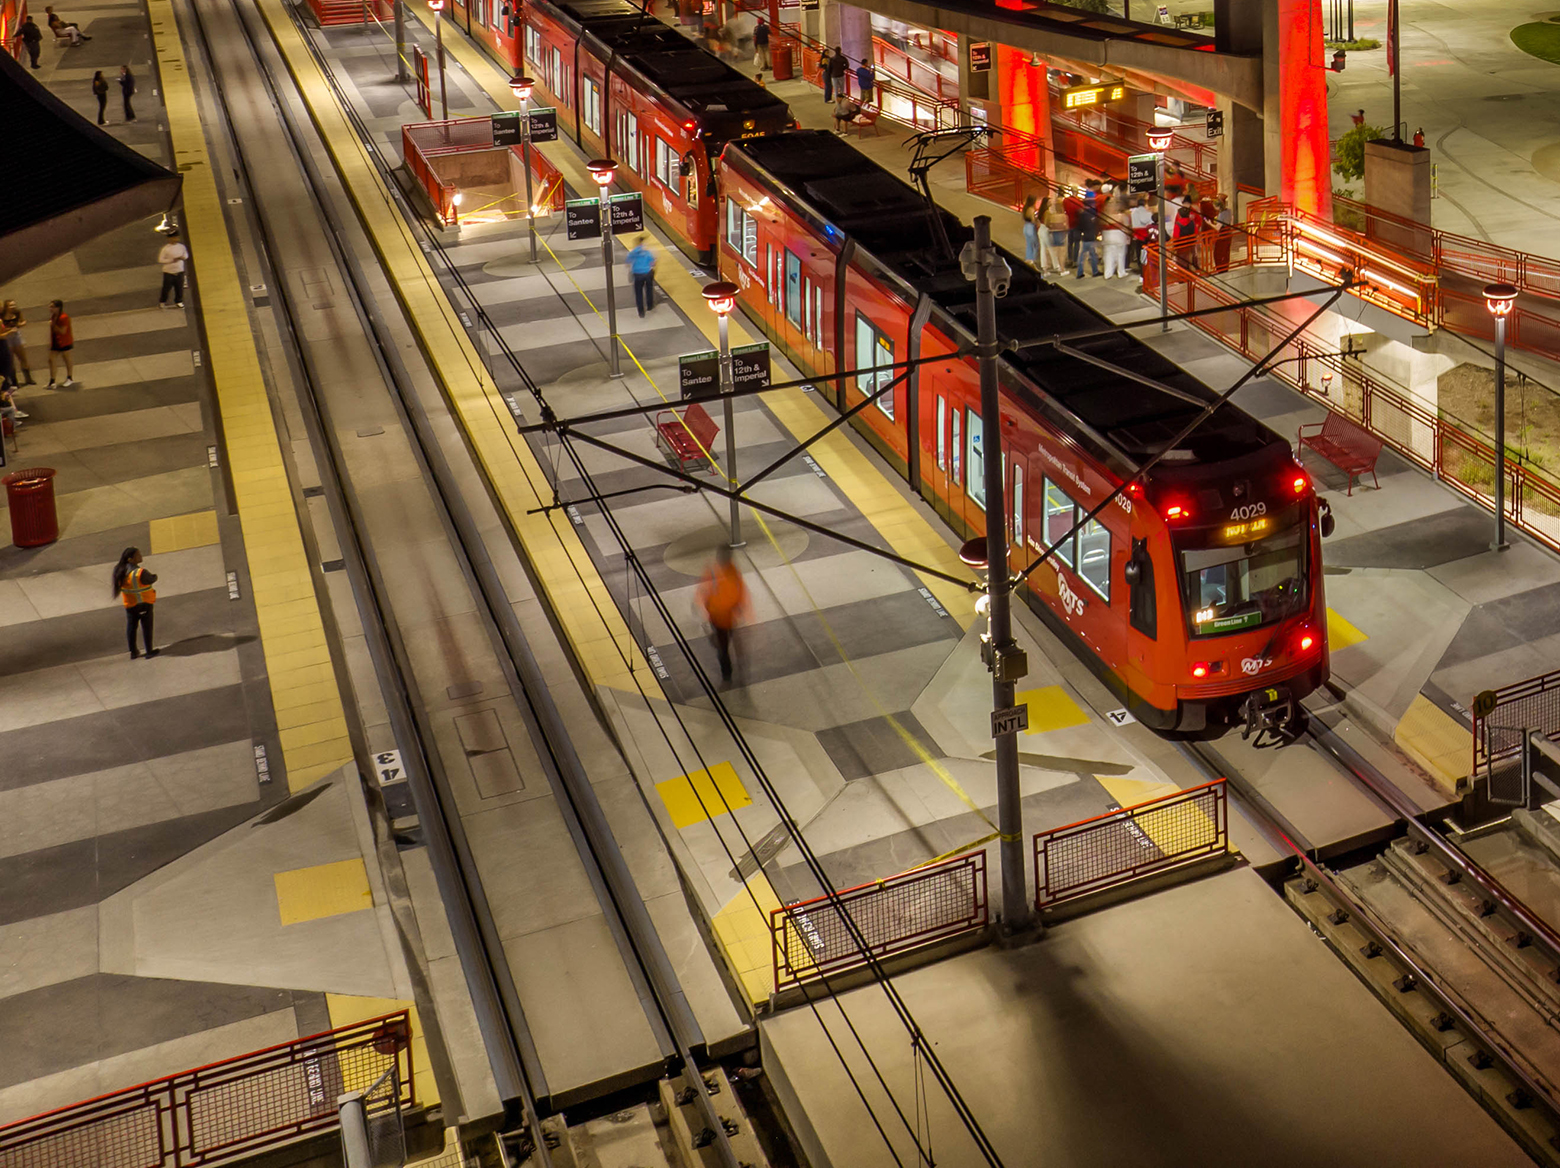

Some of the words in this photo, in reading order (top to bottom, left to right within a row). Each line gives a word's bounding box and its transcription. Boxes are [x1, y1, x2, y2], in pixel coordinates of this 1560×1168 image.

[1208, 127, 1222, 136] Exit
[568, 218, 594, 226] Santee
[612, 216, 640, 225] Imperial
[734, 358, 743, 367] To
[734, 365, 752, 374] 12th
[753, 363, 760, 371] &
[682, 369, 692, 377] To
[734, 370, 767, 383] Imperial
[682, 376, 712, 386] Santee
[1038, 443, 1063, 470] Metropolitan
[1062, 463, 1076, 482] Transit
[1075, 474, 1091, 496] System
[1230, 501, 1267, 522] 4029
[1027, 534, 1036, 547] San
[1058, 575, 1084, 616] MTS
[1241, 657, 1273, 675] MTS
[1477, 695, 1494, 713] 10
[994, 708, 1026, 721] APPROACH
[994, 717, 1026, 734] INTL
[377, 752, 396, 765] 3
[380, 768, 400, 781] 4
